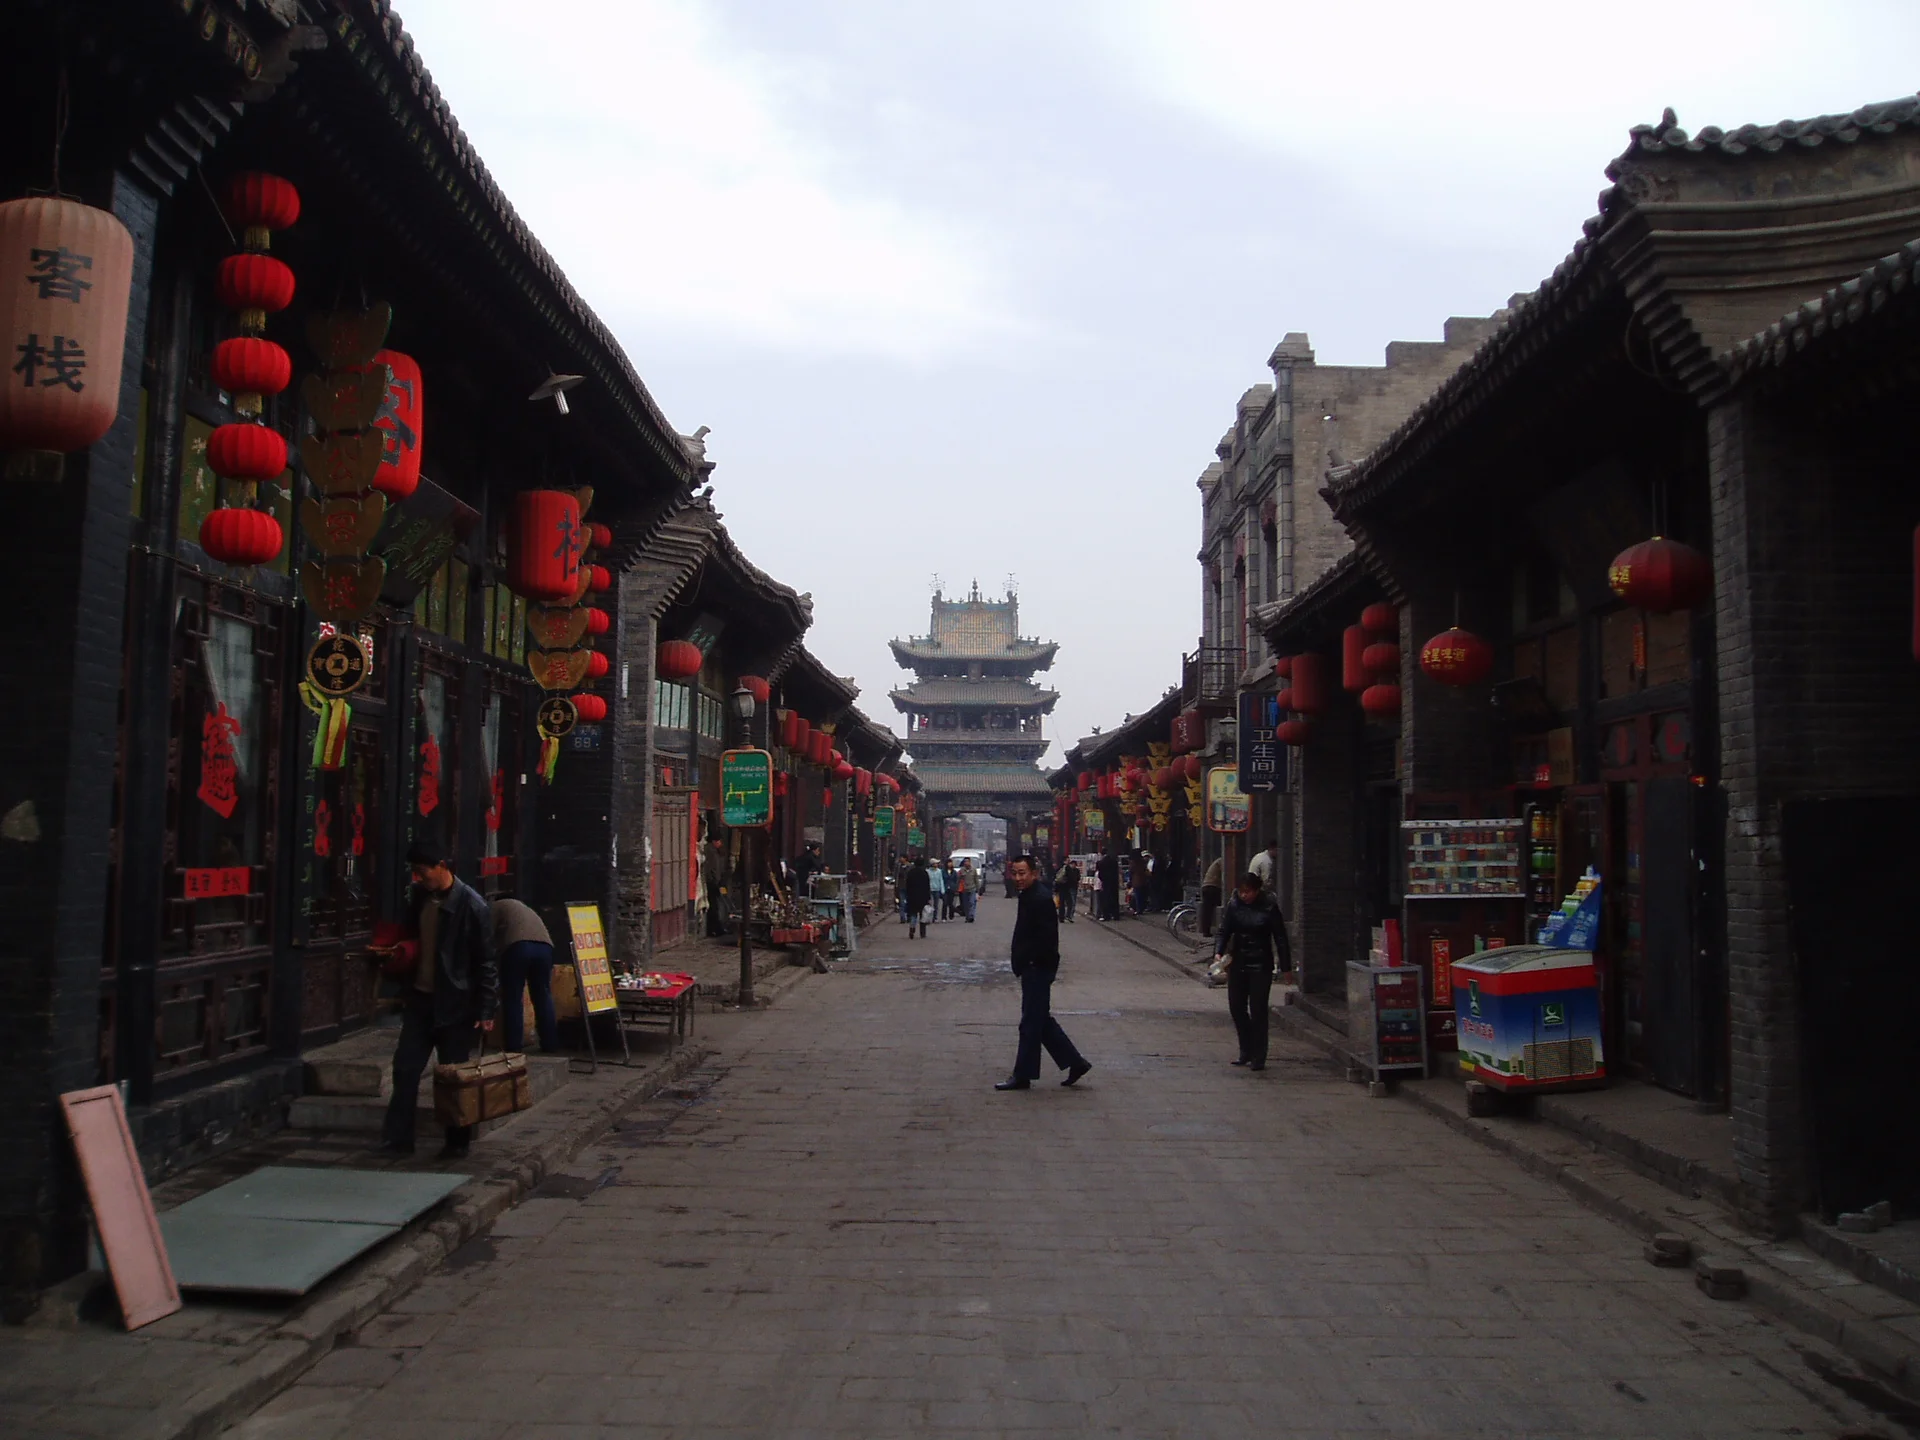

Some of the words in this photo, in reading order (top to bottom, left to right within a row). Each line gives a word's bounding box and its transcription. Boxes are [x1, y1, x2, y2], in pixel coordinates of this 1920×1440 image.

[13, 247, 93, 392] 客栈
[574, 737, 591, 748] 69
[1250, 729, 1276, 773] 卫生间
